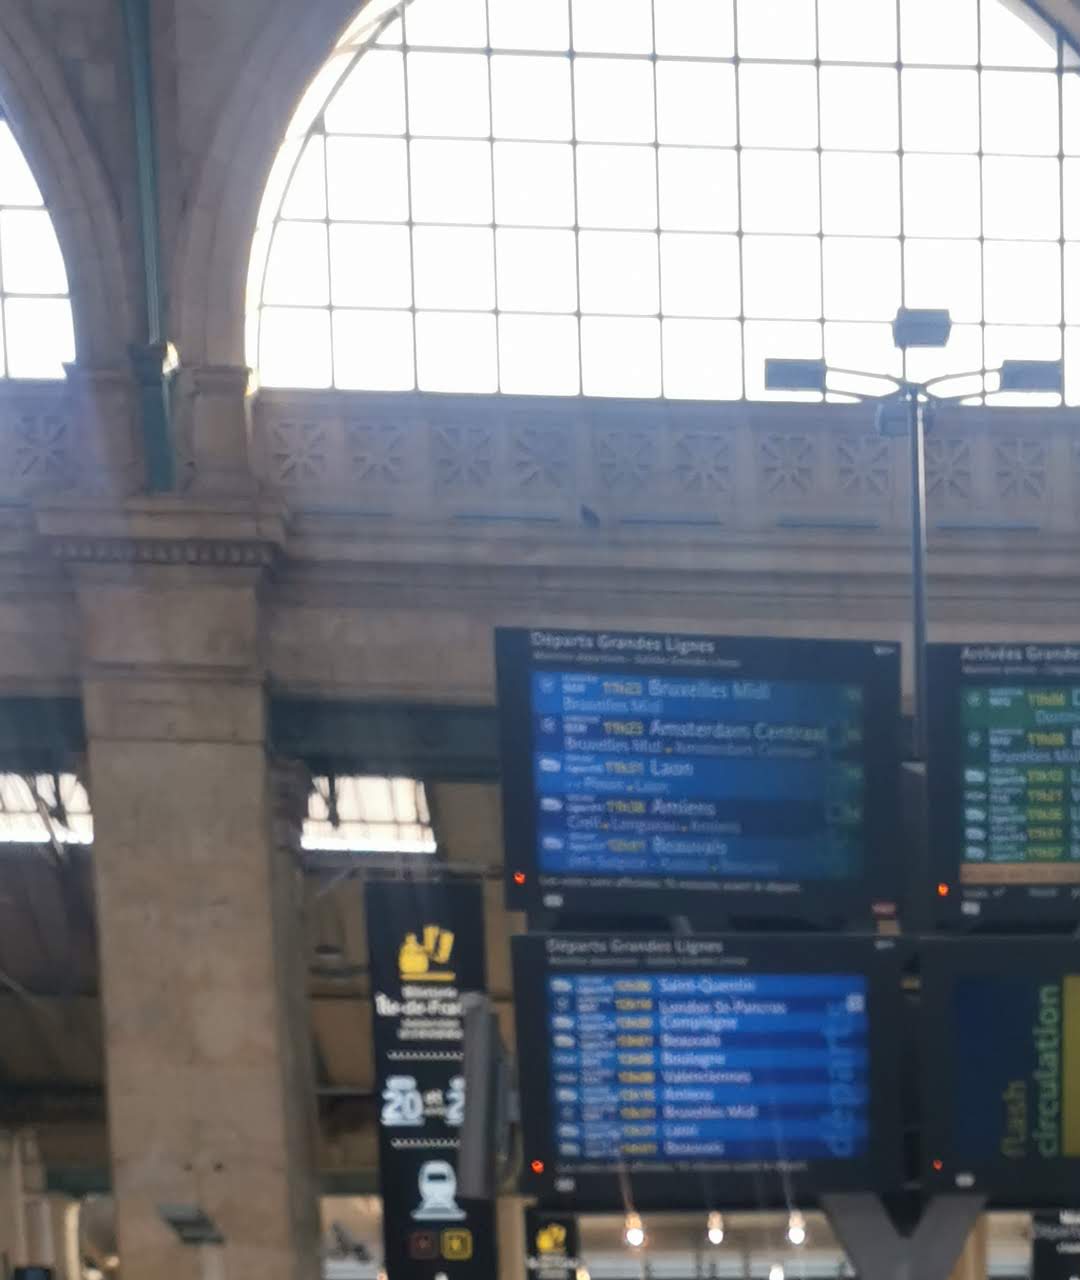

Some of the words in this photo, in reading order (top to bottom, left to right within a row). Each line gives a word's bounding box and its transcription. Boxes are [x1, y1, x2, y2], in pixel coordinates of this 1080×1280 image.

[664, 636, 715, 655] Lignes
[648, 678, 729, 699] Bruxelles
[651, 719, 751, 739] Amsterdam
[1031, 984, 1060, 1158] circulation
